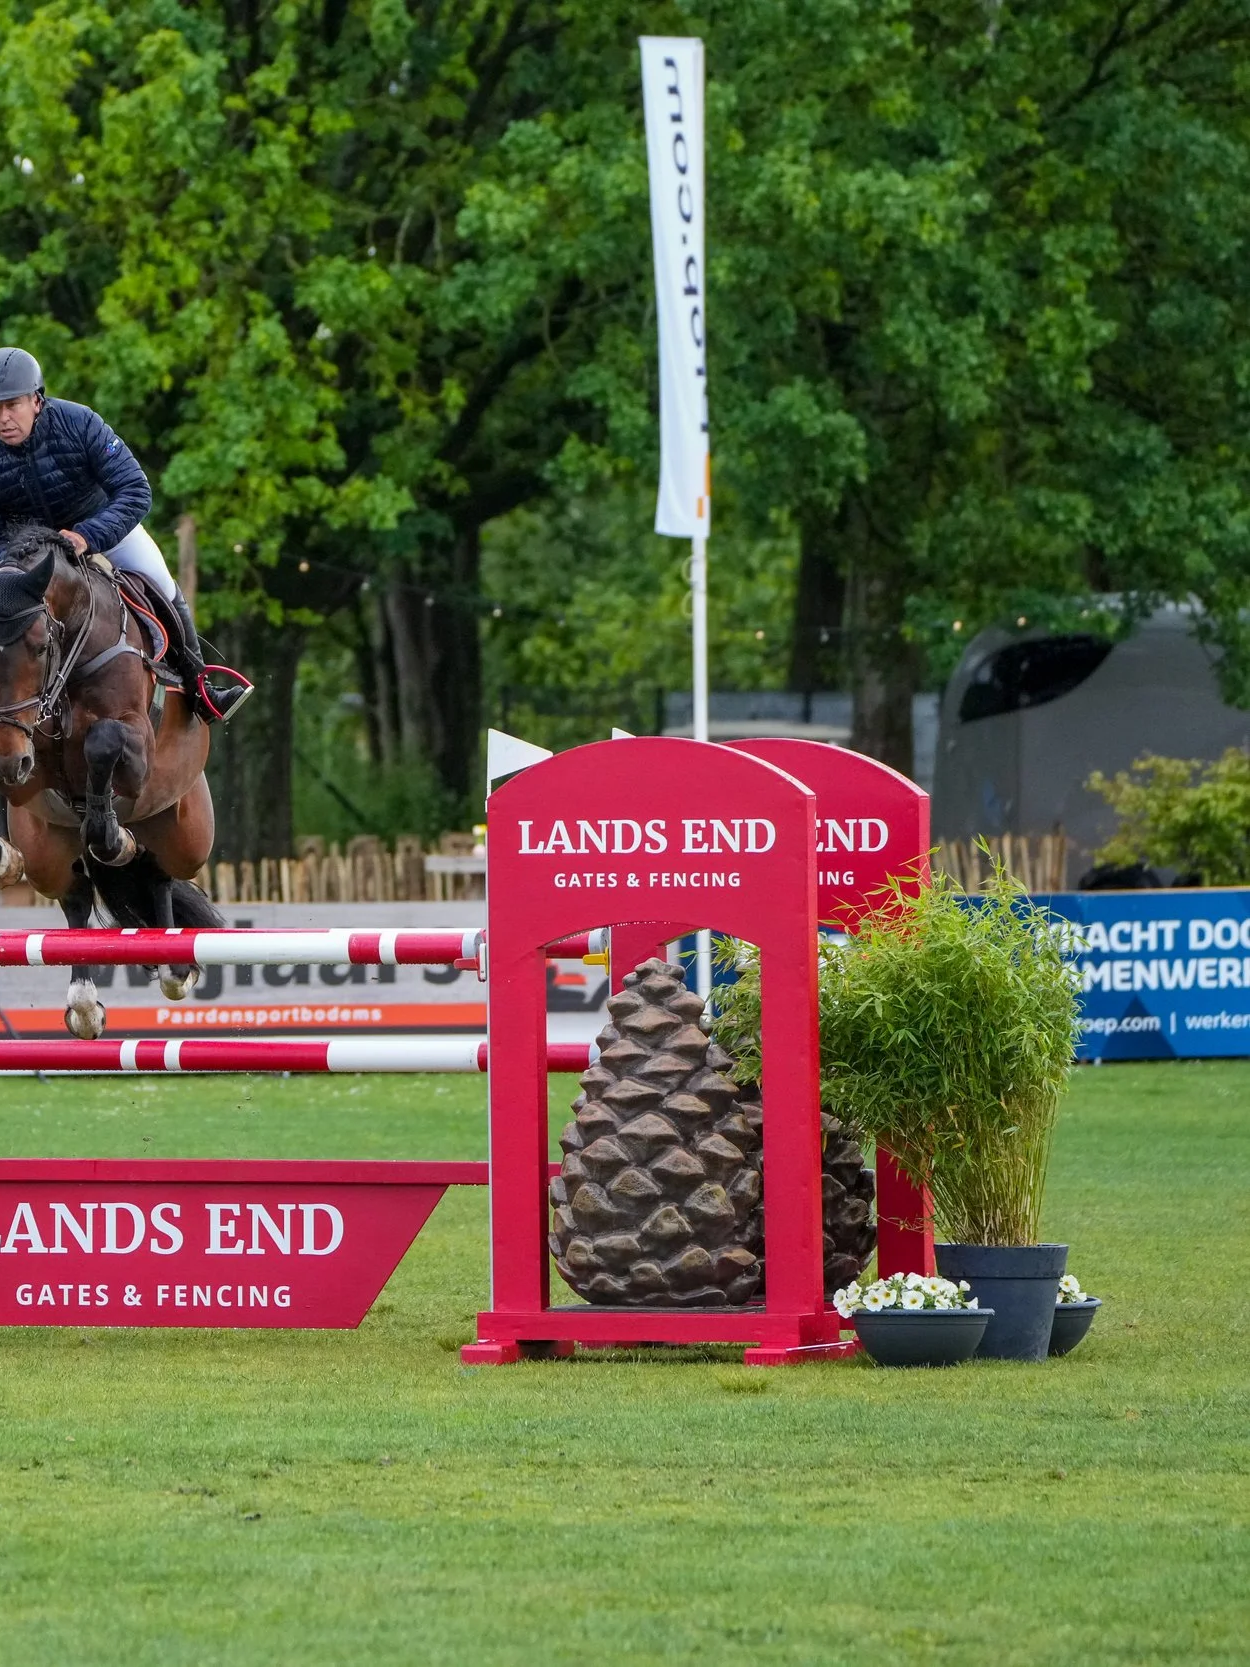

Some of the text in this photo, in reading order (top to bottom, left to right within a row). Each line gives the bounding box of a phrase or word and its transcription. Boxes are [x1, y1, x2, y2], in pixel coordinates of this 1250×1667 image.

[517, 818, 776, 854] LANDS END
[554, 872, 741, 888] GATES & FENCING
[1058, 957, 1250, 993] AMENWER
[156, 1006, 382, 1025] Paardensportbodems
[204, 1203, 344, 1256] END
[15, 1283, 291, 1307] GATES & FENCING
